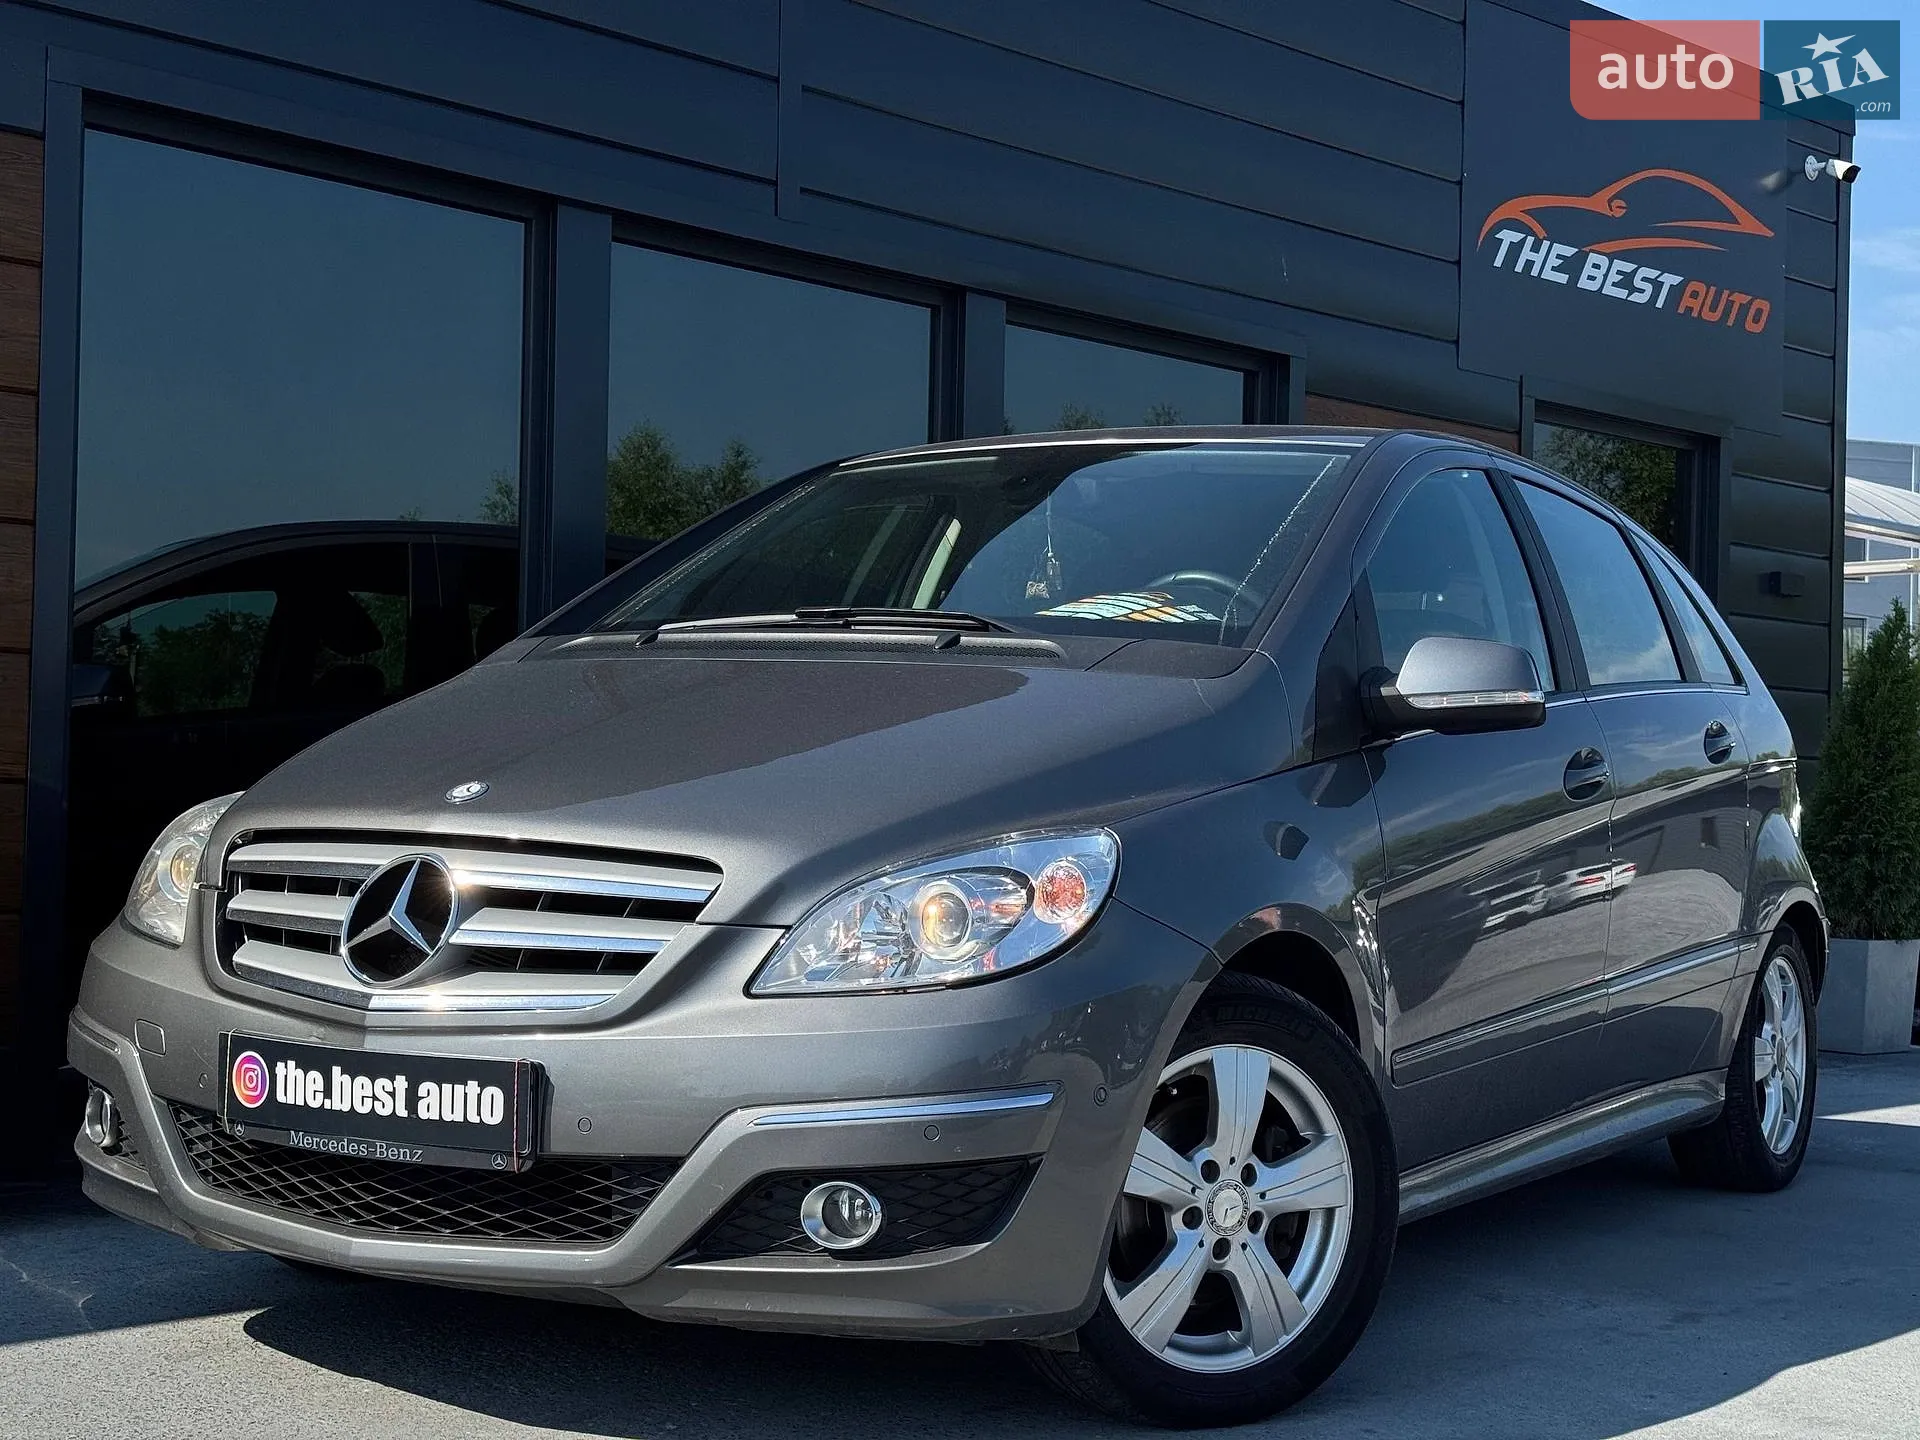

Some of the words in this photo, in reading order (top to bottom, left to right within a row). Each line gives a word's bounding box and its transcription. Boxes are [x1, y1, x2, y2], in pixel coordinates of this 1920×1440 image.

[1493, 229, 1579, 284] THE
[1576, 252, 1684, 309] BEST
[1677, 281, 1771, 333] AUTO
[275, 1060, 408, 1117] the.best
[418, 1080, 505, 1125] auto
[289, 1130, 424, 1163] Mercedes-Benz
